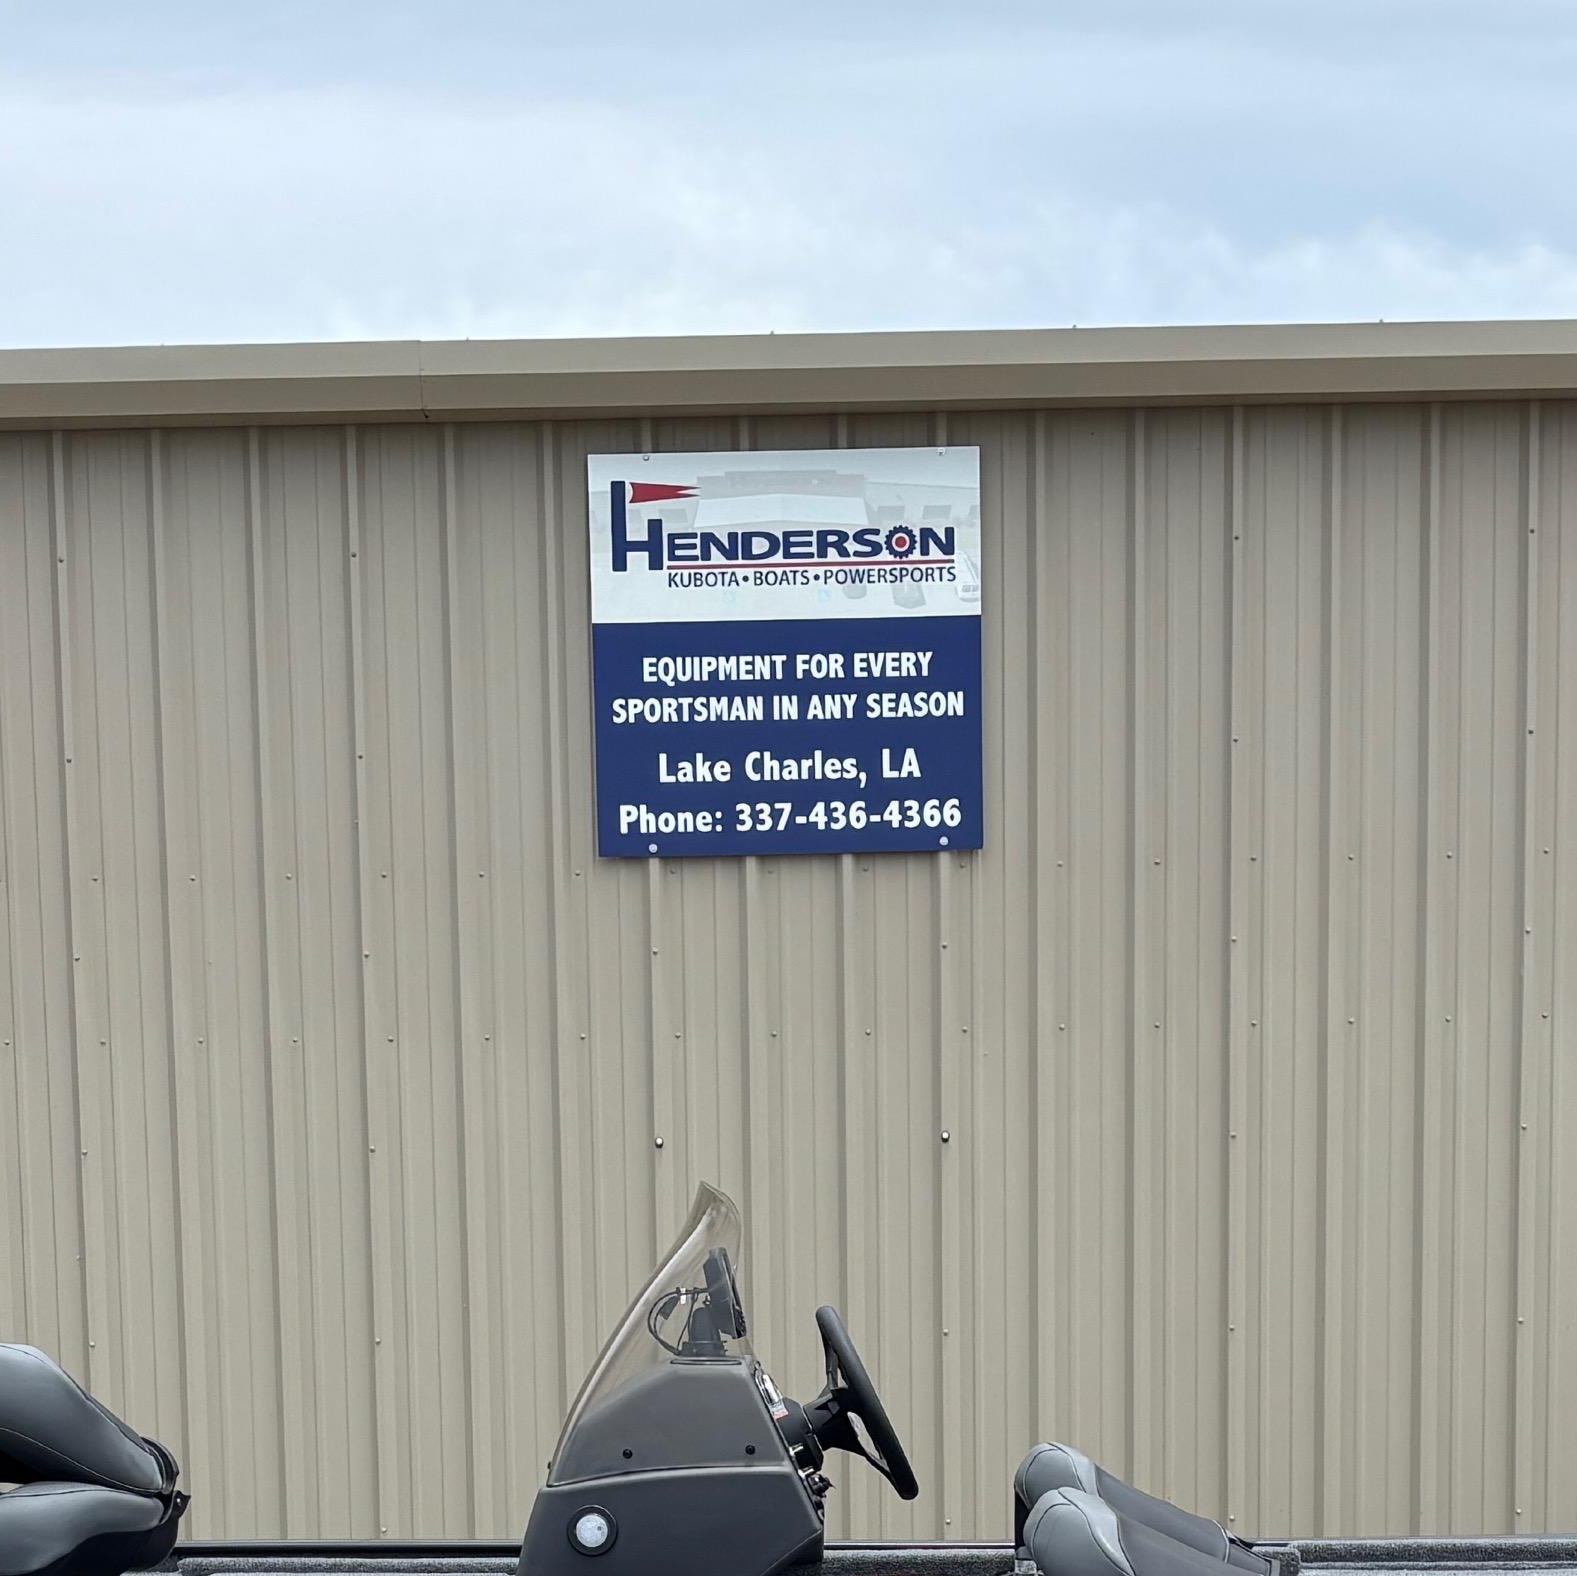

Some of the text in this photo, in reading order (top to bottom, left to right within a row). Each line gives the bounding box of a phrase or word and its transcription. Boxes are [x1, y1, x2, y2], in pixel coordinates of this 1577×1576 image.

[610, 480, 956, 573] HENDERSON
[667, 565, 957, 588] KUBOTA BOATS POWERSPORTS
[642, 651, 934, 687] EQUIPMENT FOR EVERY
[612, 690, 965, 724] SPORTSMAN IN ANY SEASON
[658, 747, 922, 789] Lake Charles, LA
[619, 798, 962, 835] Phone: 337-436-4366
